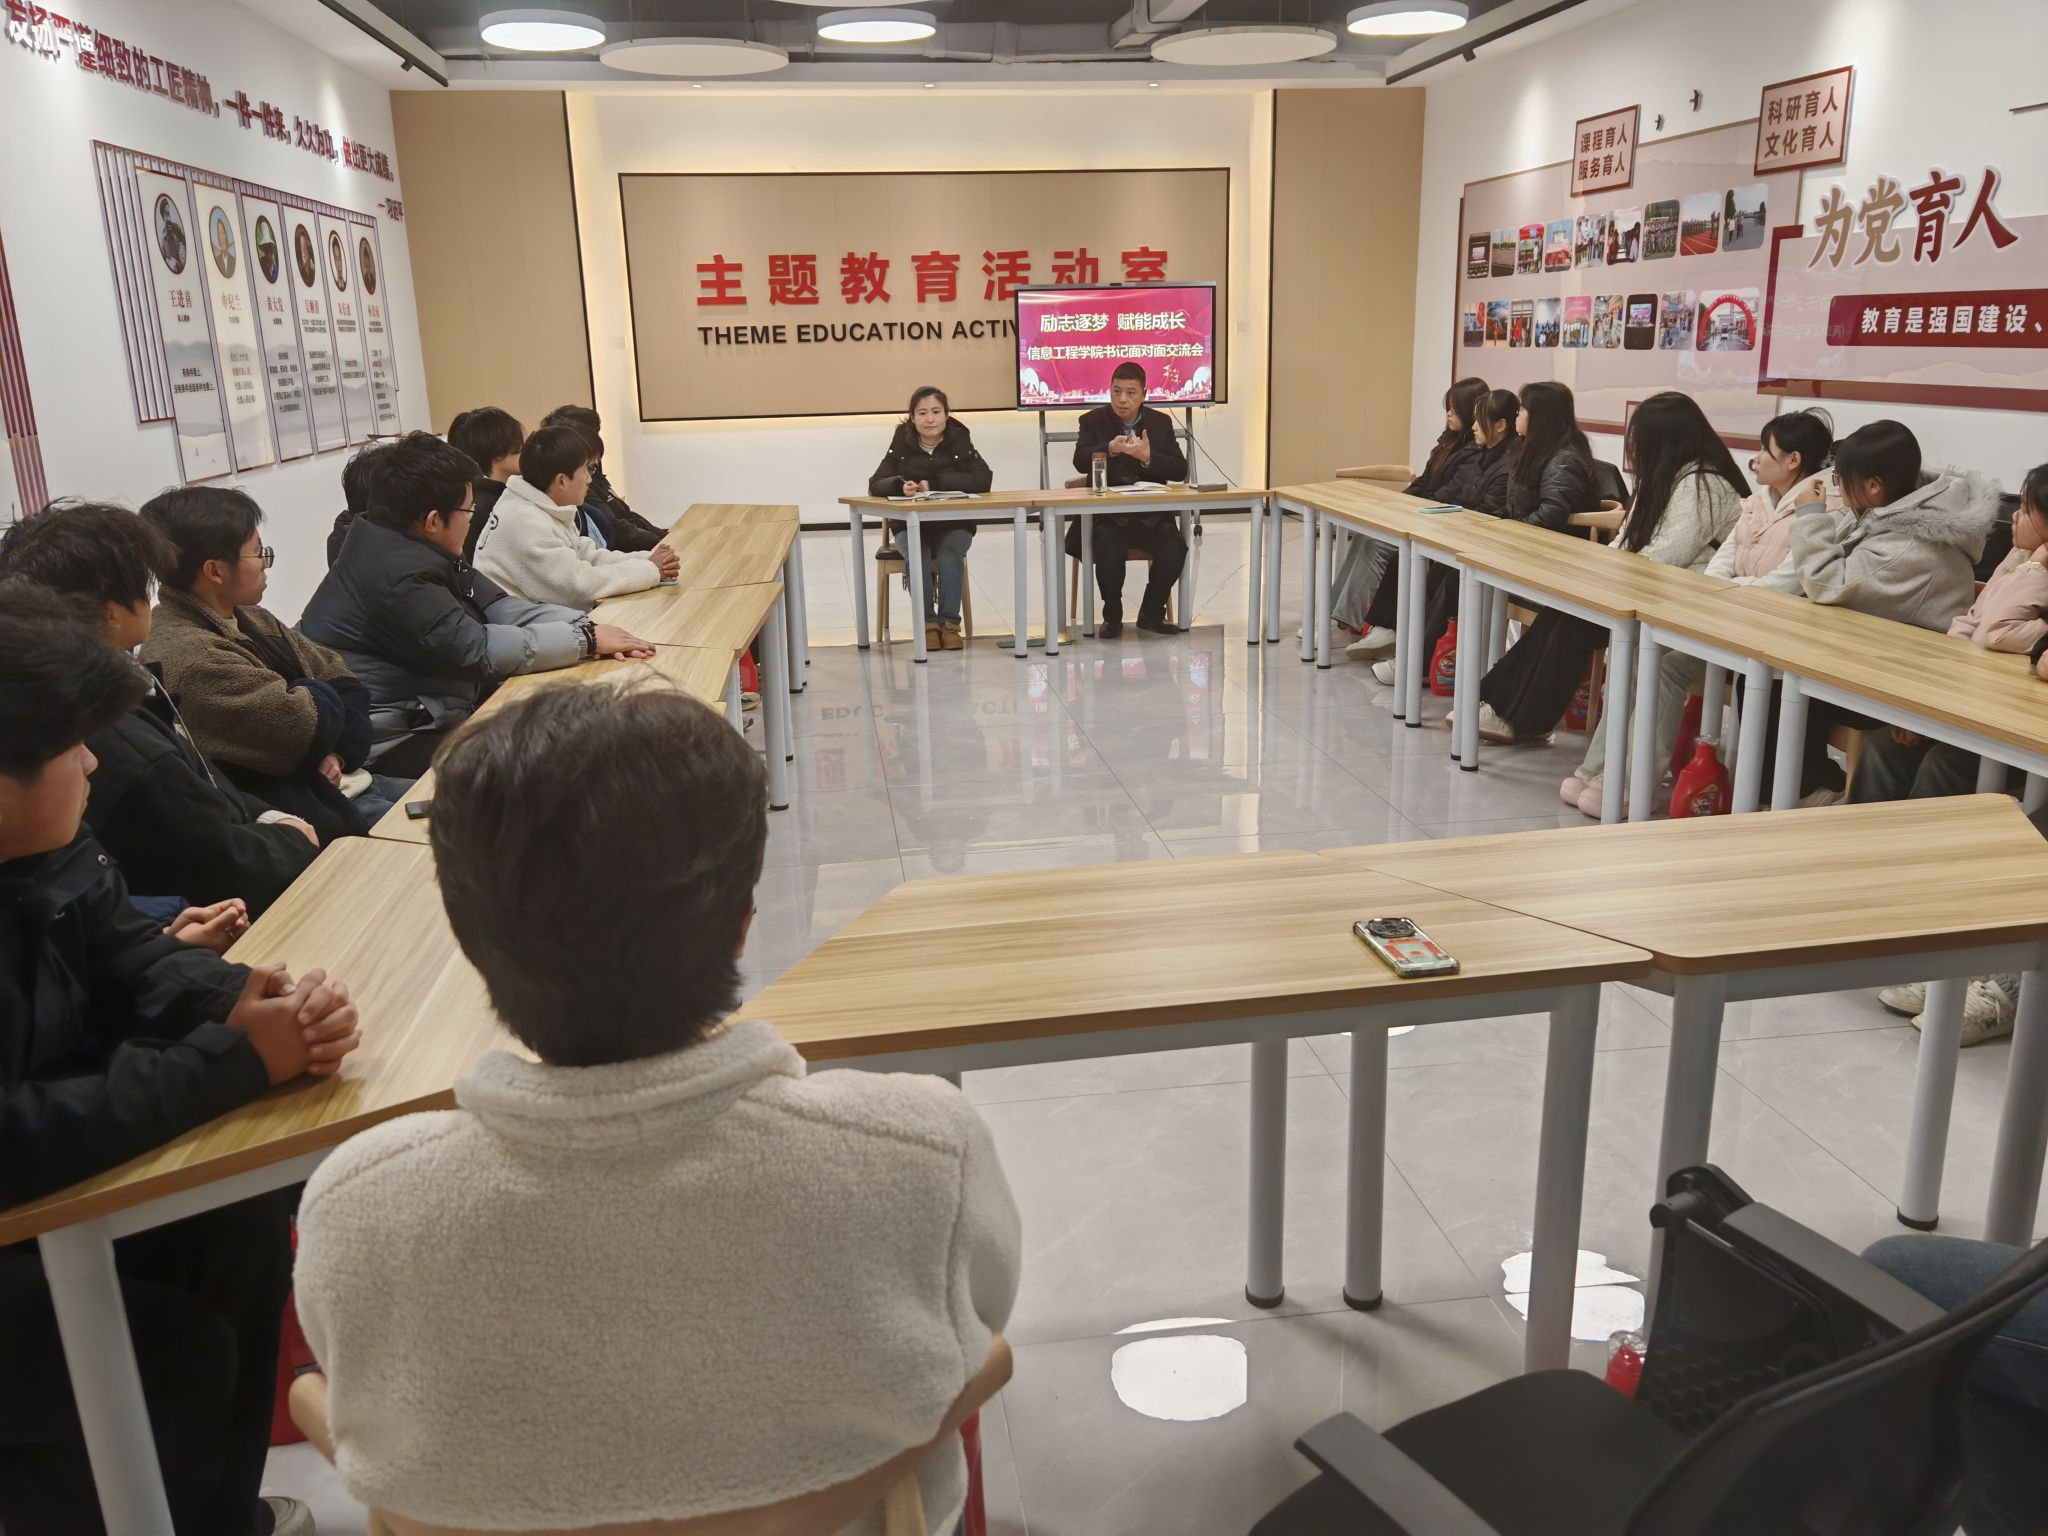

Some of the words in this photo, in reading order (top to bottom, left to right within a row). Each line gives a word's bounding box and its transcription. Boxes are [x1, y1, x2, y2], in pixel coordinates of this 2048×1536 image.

[1768, 85, 1838, 125] 科研育人
[1580, 122, 1628, 154] 课程育人
[1764, 121, 1835, 158] 文化育人
[1577, 152, 1625, 181] 服务育人
[1808, 168, 2019, 269] 为党育人
[696, 246, 1168, 306] 主题教育活动室
[698, 325, 787, 346] THEME
[796, 321, 943, 344] EDUCATION
[1040, 313, 1109, 333] 励志逐梦
[1117, 311, 1186, 331] 赋能成长
[1026, 342, 1204, 361] 信息工程学院书记面对面交流会
